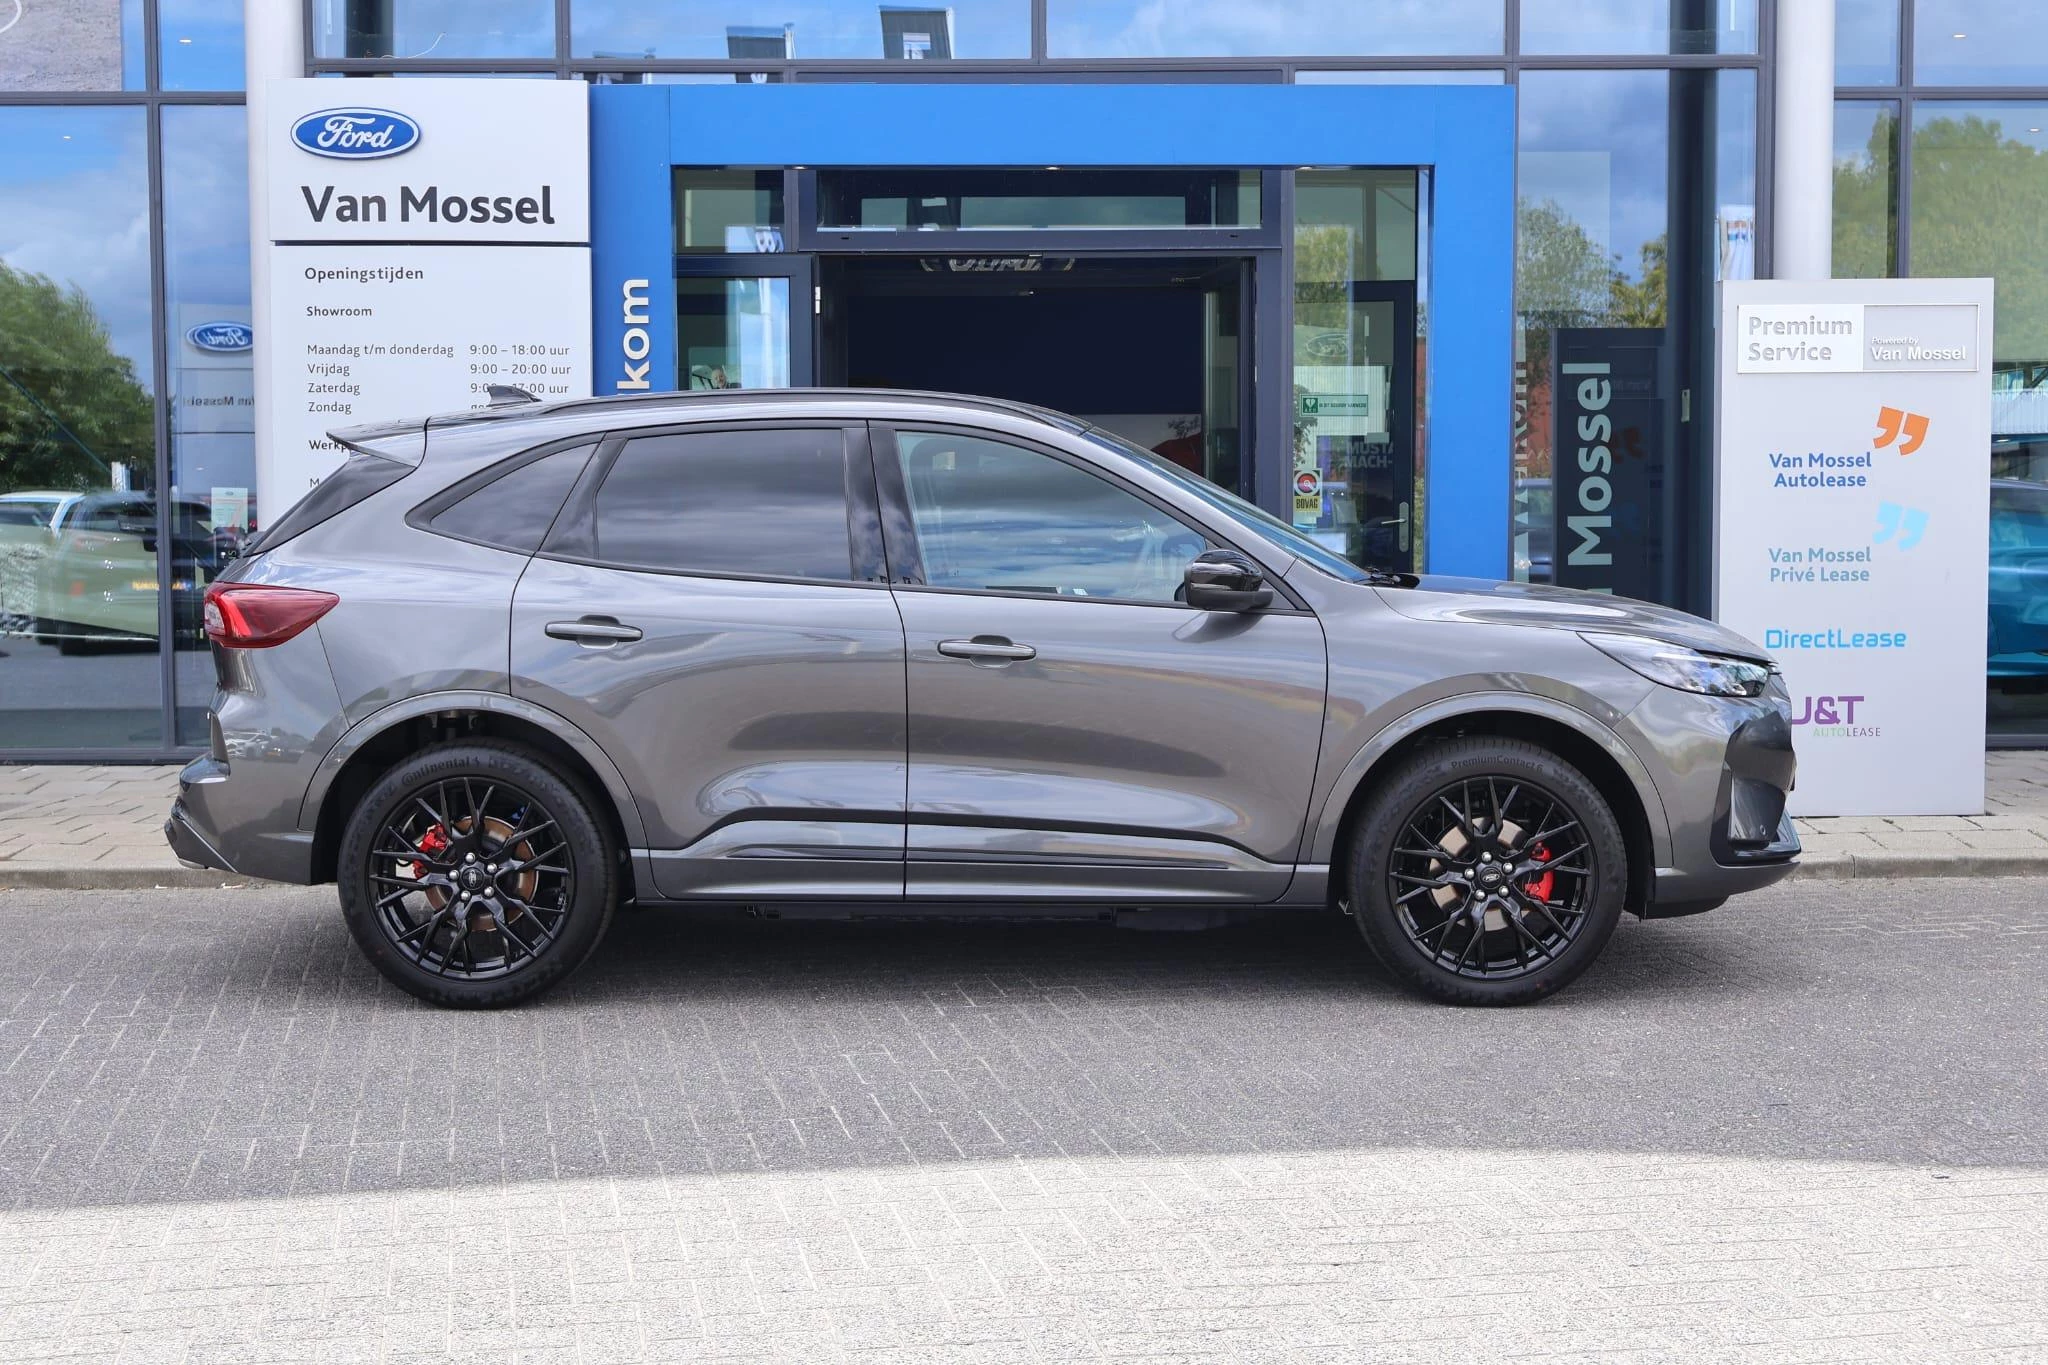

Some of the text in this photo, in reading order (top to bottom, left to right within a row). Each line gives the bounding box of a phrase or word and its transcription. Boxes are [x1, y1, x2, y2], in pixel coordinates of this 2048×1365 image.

[316, 115, 396, 149] Ford
[301, 185, 555, 225] Van Mossel
[304, 267, 424, 284] Openingstijden
[306, 305, 372, 317] Showroom
[1748, 315, 1853, 336] Premium
[616, 279, 650, 390] kom
[307, 344, 360, 358] Maandag
[364, 344, 386, 356] t/m
[389, 344, 454, 358] donderdag
[469, 344, 498, 355] 9:00
[512, 344, 546, 355] 18:00
[549, 347, 570, 355] uur
[1748, 342, 1832, 362] Service
[1871, 344, 1967, 361] Van Mossel
[307, 363, 350, 377] Vrijdag
[470, 364, 498, 375] 9:00
[511, 364, 547, 375] 20:00
[551, 366, 571, 375] uur
[307, 382, 361, 396] Zaterdag
[470, 383, 497, 394] 9:0
[549, 385, 569, 394] uur
[308, 401, 352, 415] Zondag
[308, 439, 351, 453] Werkp
[1561, 362, 1613, 566] Mossel
[1769, 452, 1872, 468] Van Mossel
[1774, 472, 1867, 488] Autolease
[1295, 498, 1319, 510] BOVAG
[1768, 547, 1872, 563] Van Mossel
[1770, 567, 1870, 582] Privé Lease
[1765, 629, 1907, 649] DirectLease
[1791, 695, 1865, 725] J&T
[1813, 727, 1881, 737] AUTOLEASE
